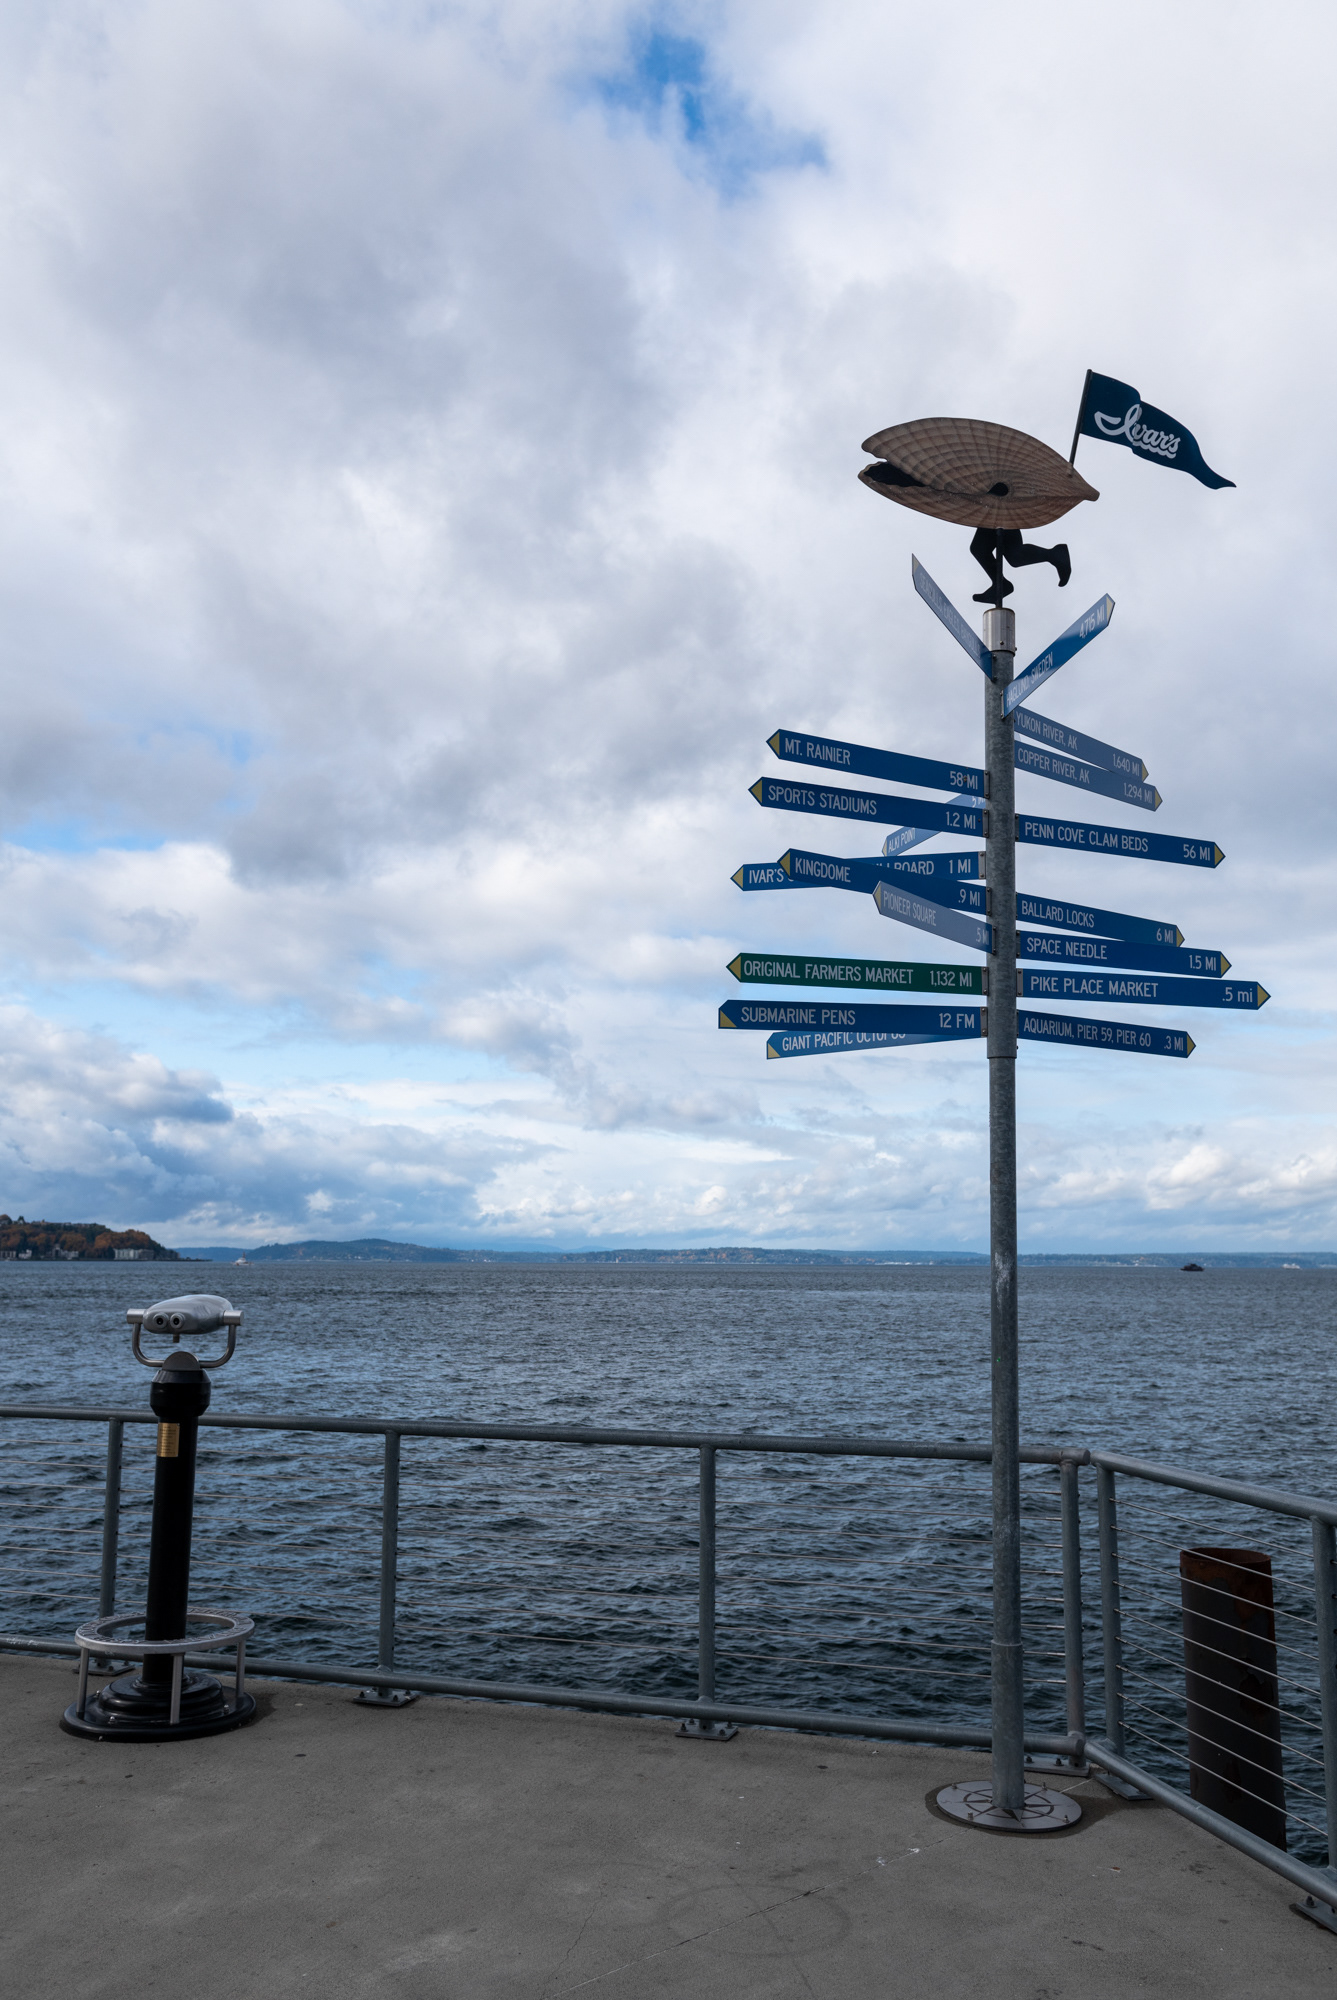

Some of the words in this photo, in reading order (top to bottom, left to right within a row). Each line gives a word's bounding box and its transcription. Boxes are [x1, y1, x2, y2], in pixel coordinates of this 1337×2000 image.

[1094, 404, 1181, 457] Ivar's
[1031, 652, 1054, 684] SWEDEN
[1096, 604, 1105, 626] MI
[1015, 711, 1041, 735] YUKON
[1043, 723, 1066, 746] RIVER,
[1068, 735, 1078, 751] AK
[1112, 753, 1131, 773] 1,640
[1131, 761, 1141, 777] MI
[784, 737, 803, 756] MT.
[806, 742, 851, 766] RAINIER
[949, 771, 963, 787] 58
[966, 777, 978, 791] MI
[1017, 748, 1050, 771] COPPER
[1079, 768, 1091, 784] AK
[1123, 782, 1143, 801] 1,294
[1144, 789, 1153, 804] MI
[767, 785, 816, 807] SPORTS
[819, 792, 877, 816] STADIUMS
[945, 811, 961, 828] 1.2
[963, 814, 976, 830] MI
[888, 839, 903, 857] ALKI
[902, 827, 916, 849] POINT
[1024, 821, 1054, 840] PENN
[1057, 826, 1085, 844] COVE
[1088, 830, 1118, 848] CLAM
[1121, 835, 1149, 853] BEDS
[1183, 844, 1197, 859] 56
[1200, 846, 1211, 861] MI
[748, 867, 785, 884] IVAR'S
[957, 858, 972, 874] MI
[794, 857, 852, 883] KINGDOME
[957, 888, 967, 904] .9
[969, 891, 981, 907] MI
[883, 890, 911, 917] PIONEER
[912, 902, 937, 927] SQUARE
[1021, 901, 1064, 922] BALLARD
[1066, 908, 1095, 928] LOCKS
[1156, 928, 1163, 942] 6
[1164, 929, 1174, 944] MI
[1026, 937, 1061, 955] SPACE
[1065, 942, 1108, 960] NEEDLE
[1188, 955, 1202, 970] 1.5
[1205, 957, 1217, 971] MI
[743, 960, 801, 979] ORIGINAL
[805, 963, 862, 982] FARMERS
[865, 967, 914, 985] MARKET
[930, 970, 956, 987] 1,132
[959, 972, 973, 988] MI
[1030, 976, 1059, 993] PIKE
[1063, 979, 1104, 995] PLACE
[1108, 981, 1159, 998] MARKET
[1222, 987, 1233, 1002] .5
[1237, 988, 1254, 1003] mi
[740, 1007, 816, 1025] SUBMARINE
[821, 1009, 856, 1026] PENS
[939, 1012, 952, 1028] 12
[956, 1013, 975, 1029] FM
[1023, 1017, 1075, 1040] AQUARIUM,
[1077, 1024, 1099, 1041] PIER
[1100, 1027, 1114, 1043] 59,
[1116, 1028, 1136, 1045] PIER
[1139, 1032, 1151, 1047] 60
[1174, 1036, 1184, 1051] MI
[782, 1034, 811, 1051] GIANT
[814, 1031, 853, 1048] PACIFIC
